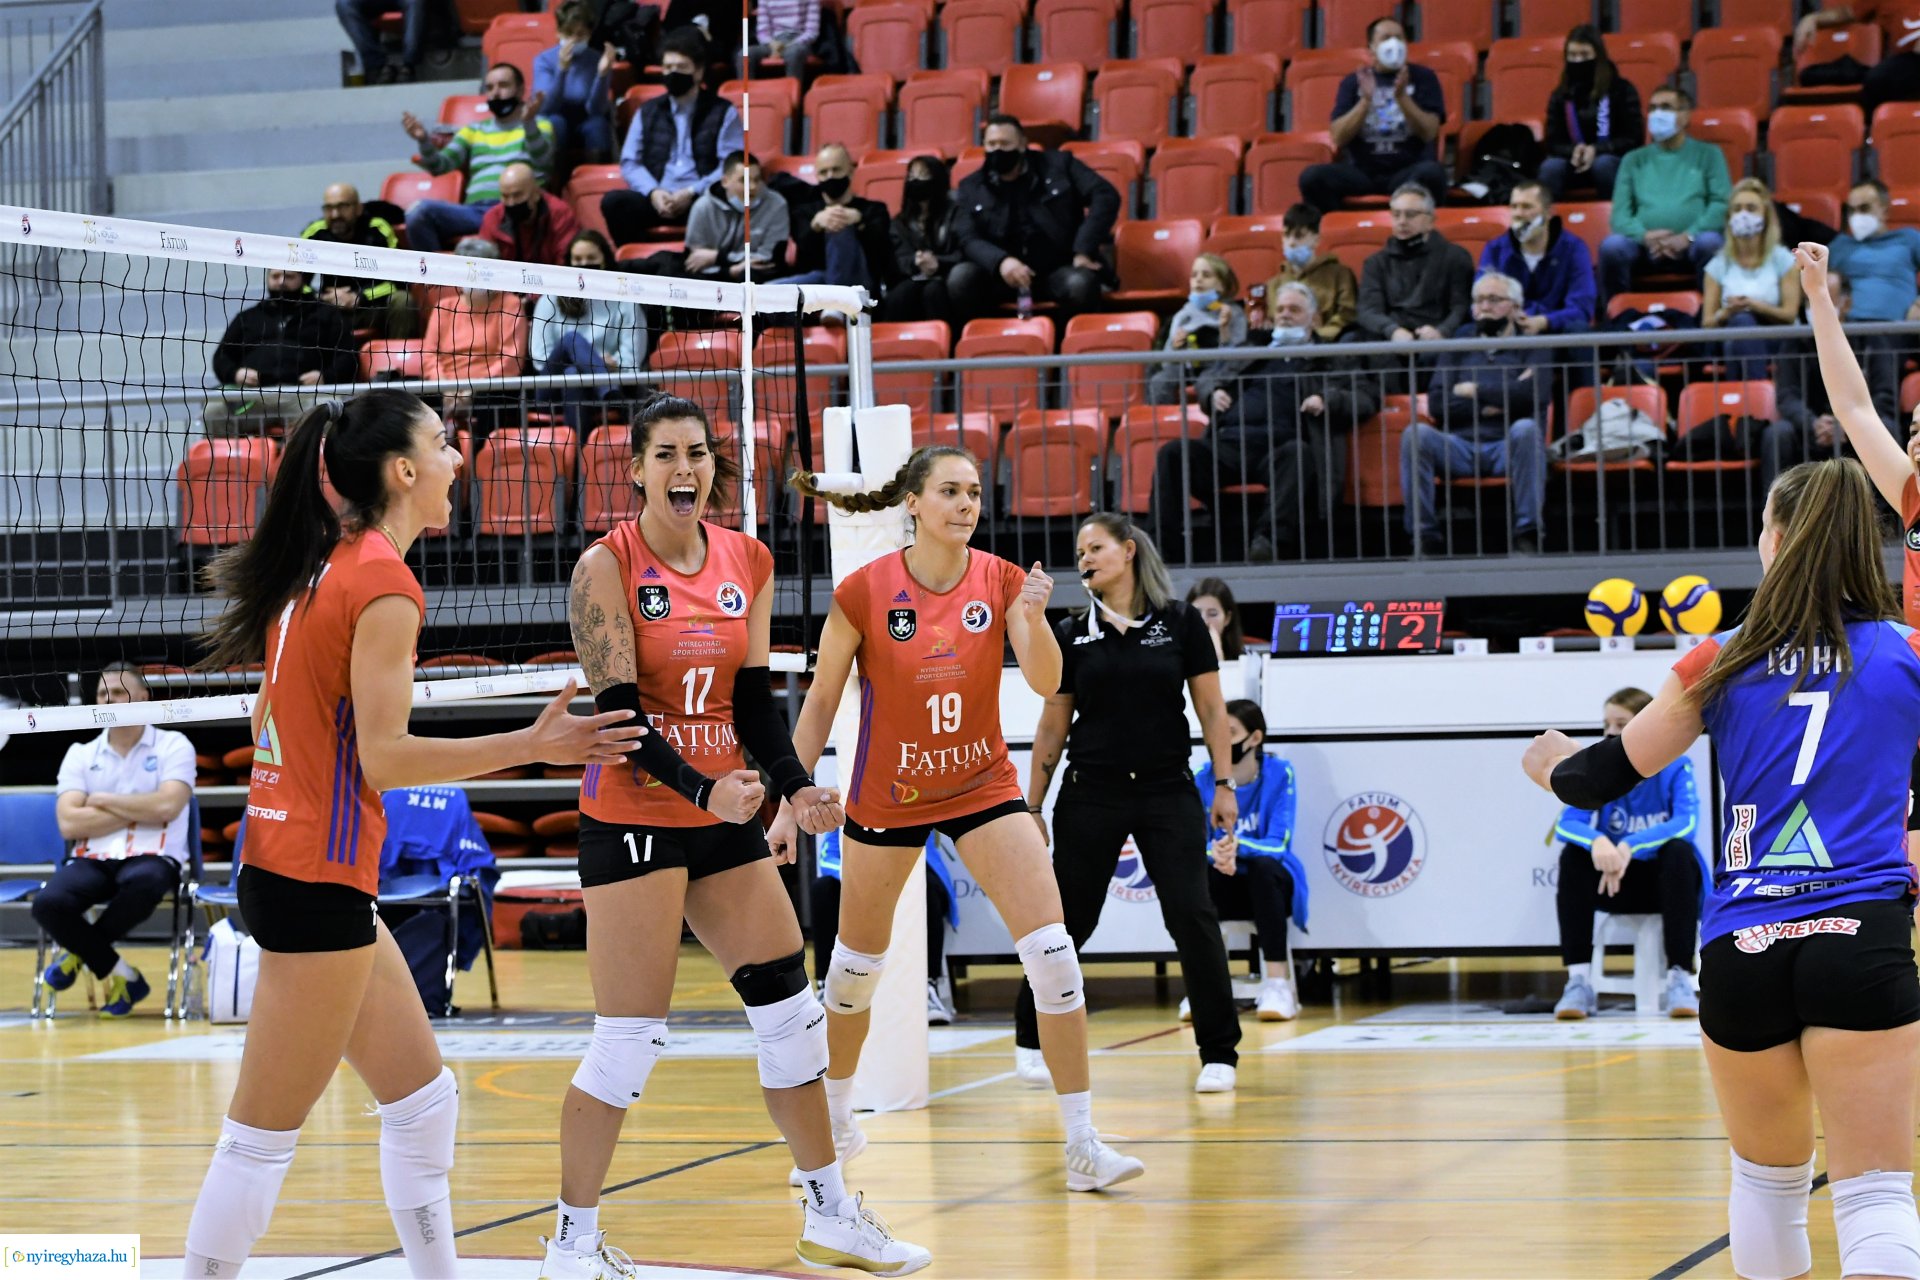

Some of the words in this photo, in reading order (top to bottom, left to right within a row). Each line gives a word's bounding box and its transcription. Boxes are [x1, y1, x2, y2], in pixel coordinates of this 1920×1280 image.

[160, 231, 188, 250] FATUM
[354, 251, 379, 270] FATUM
[1292, 617, 1311, 651] 1
[1397, 615, 1425, 649] 2
[672, 648, 726, 656] SPORTCENTRUM
[916, 670, 966, 680] SPORTCENTRUM
[682, 666, 715, 715] 17
[92, 708, 117, 723] FATUM
[926, 692, 962, 735] 19
[1789, 691, 1830, 786] 7
[897, 736, 991, 770] FATUM
[897, 753, 992, 777] PROPERTY
[1347, 794, 1400, 810] FATUM
[1779, 919, 1859, 937] REVESZ
[1044, 945, 1067, 956] MIKASA
[845, 968, 868, 977] MIKASA
[807, 1180, 824, 1207] MIKASA
[413, 1204, 438, 1245] MIKASA
[560, 1214, 574, 1242] MIKASA
